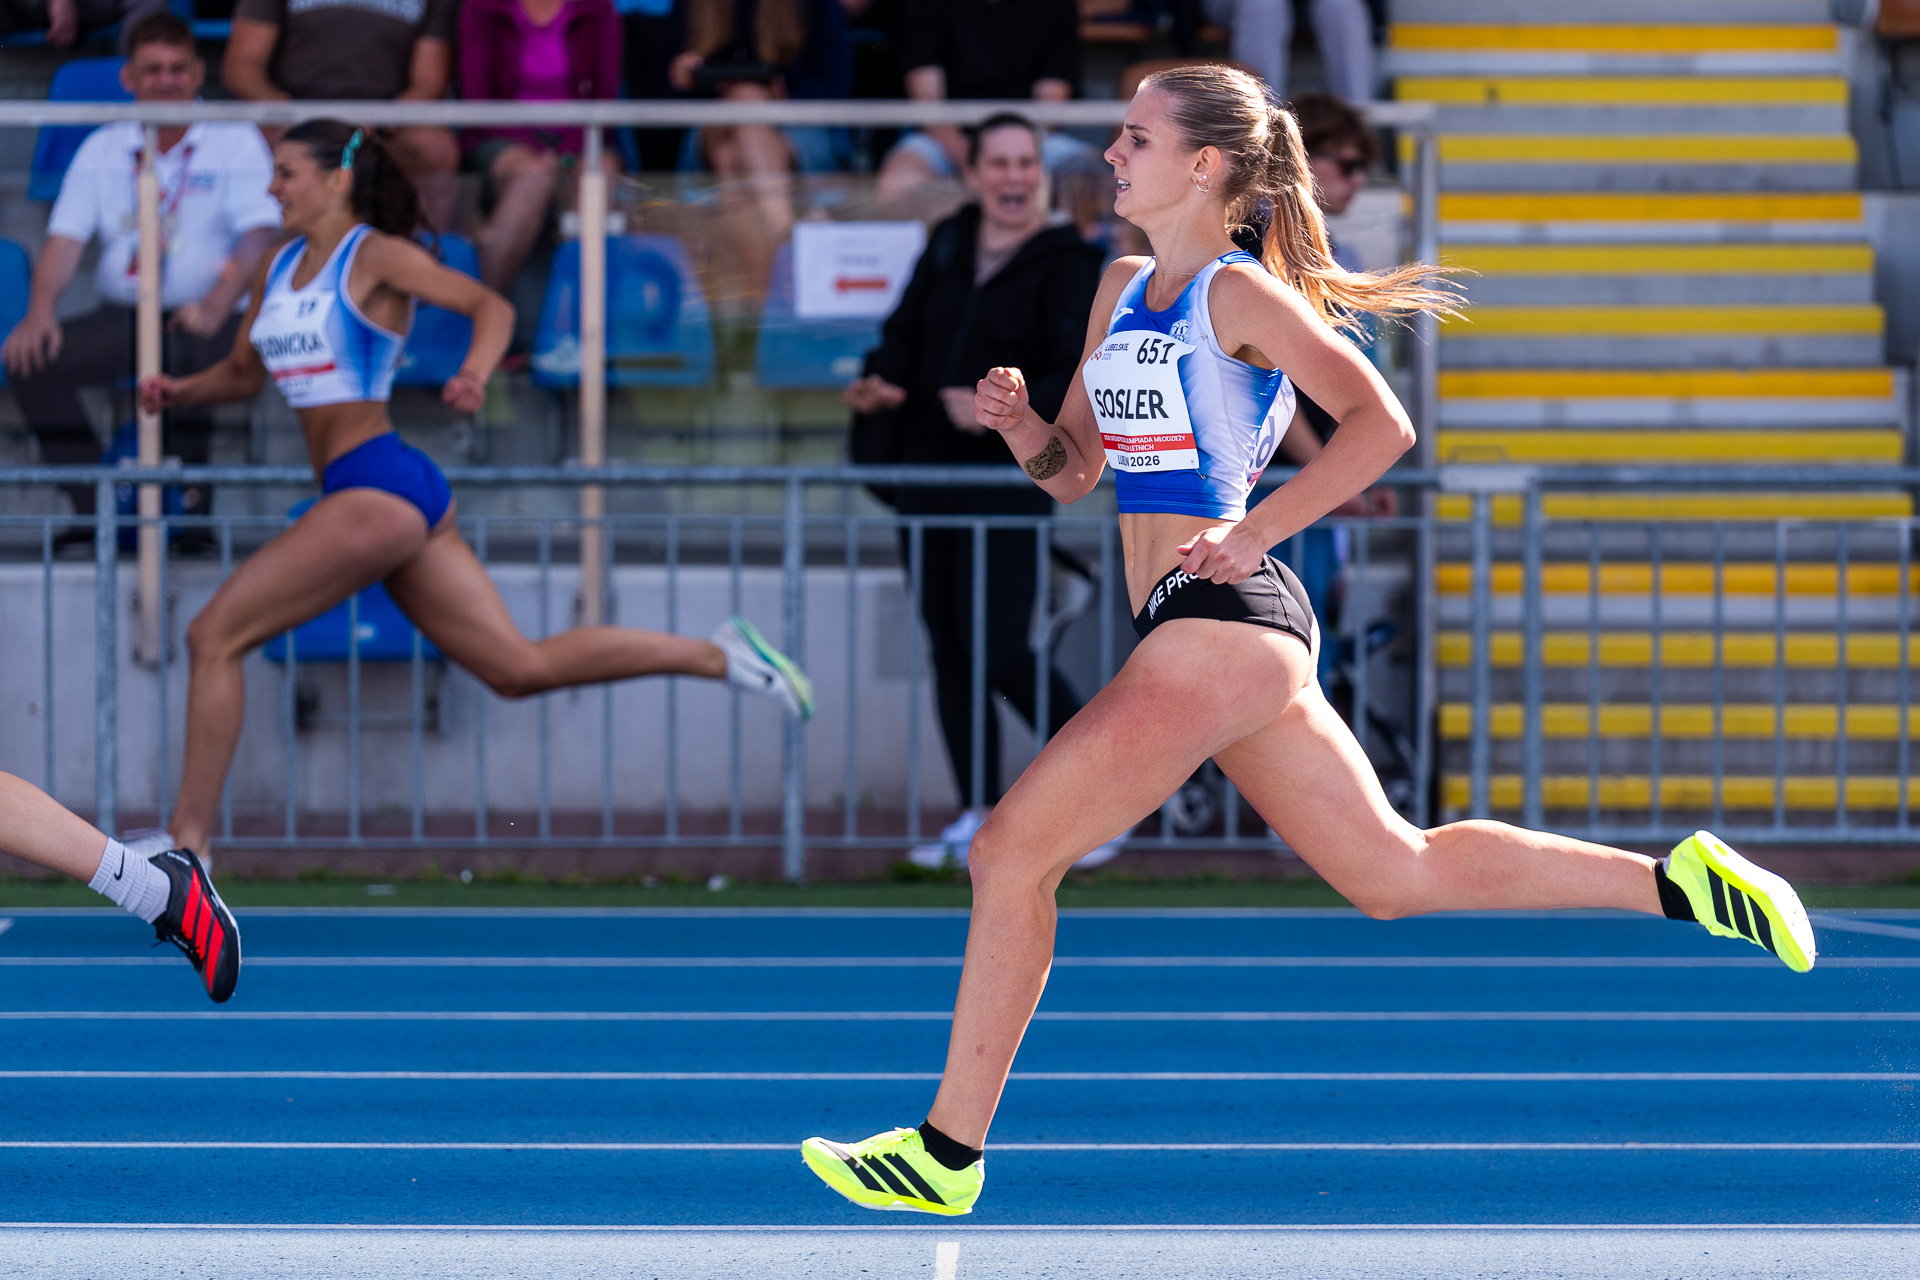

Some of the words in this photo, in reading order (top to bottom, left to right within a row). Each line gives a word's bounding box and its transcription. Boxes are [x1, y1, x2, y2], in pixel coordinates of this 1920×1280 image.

[1137, 338, 1176, 364] 651
[1094, 388, 1170, 419] SOSLER
[1154, 434, 1186, 443] MŁODZIEŻY
[1130, 455, 1160, 467] 2026
[1147, 584, 1165, 620] NIKE
